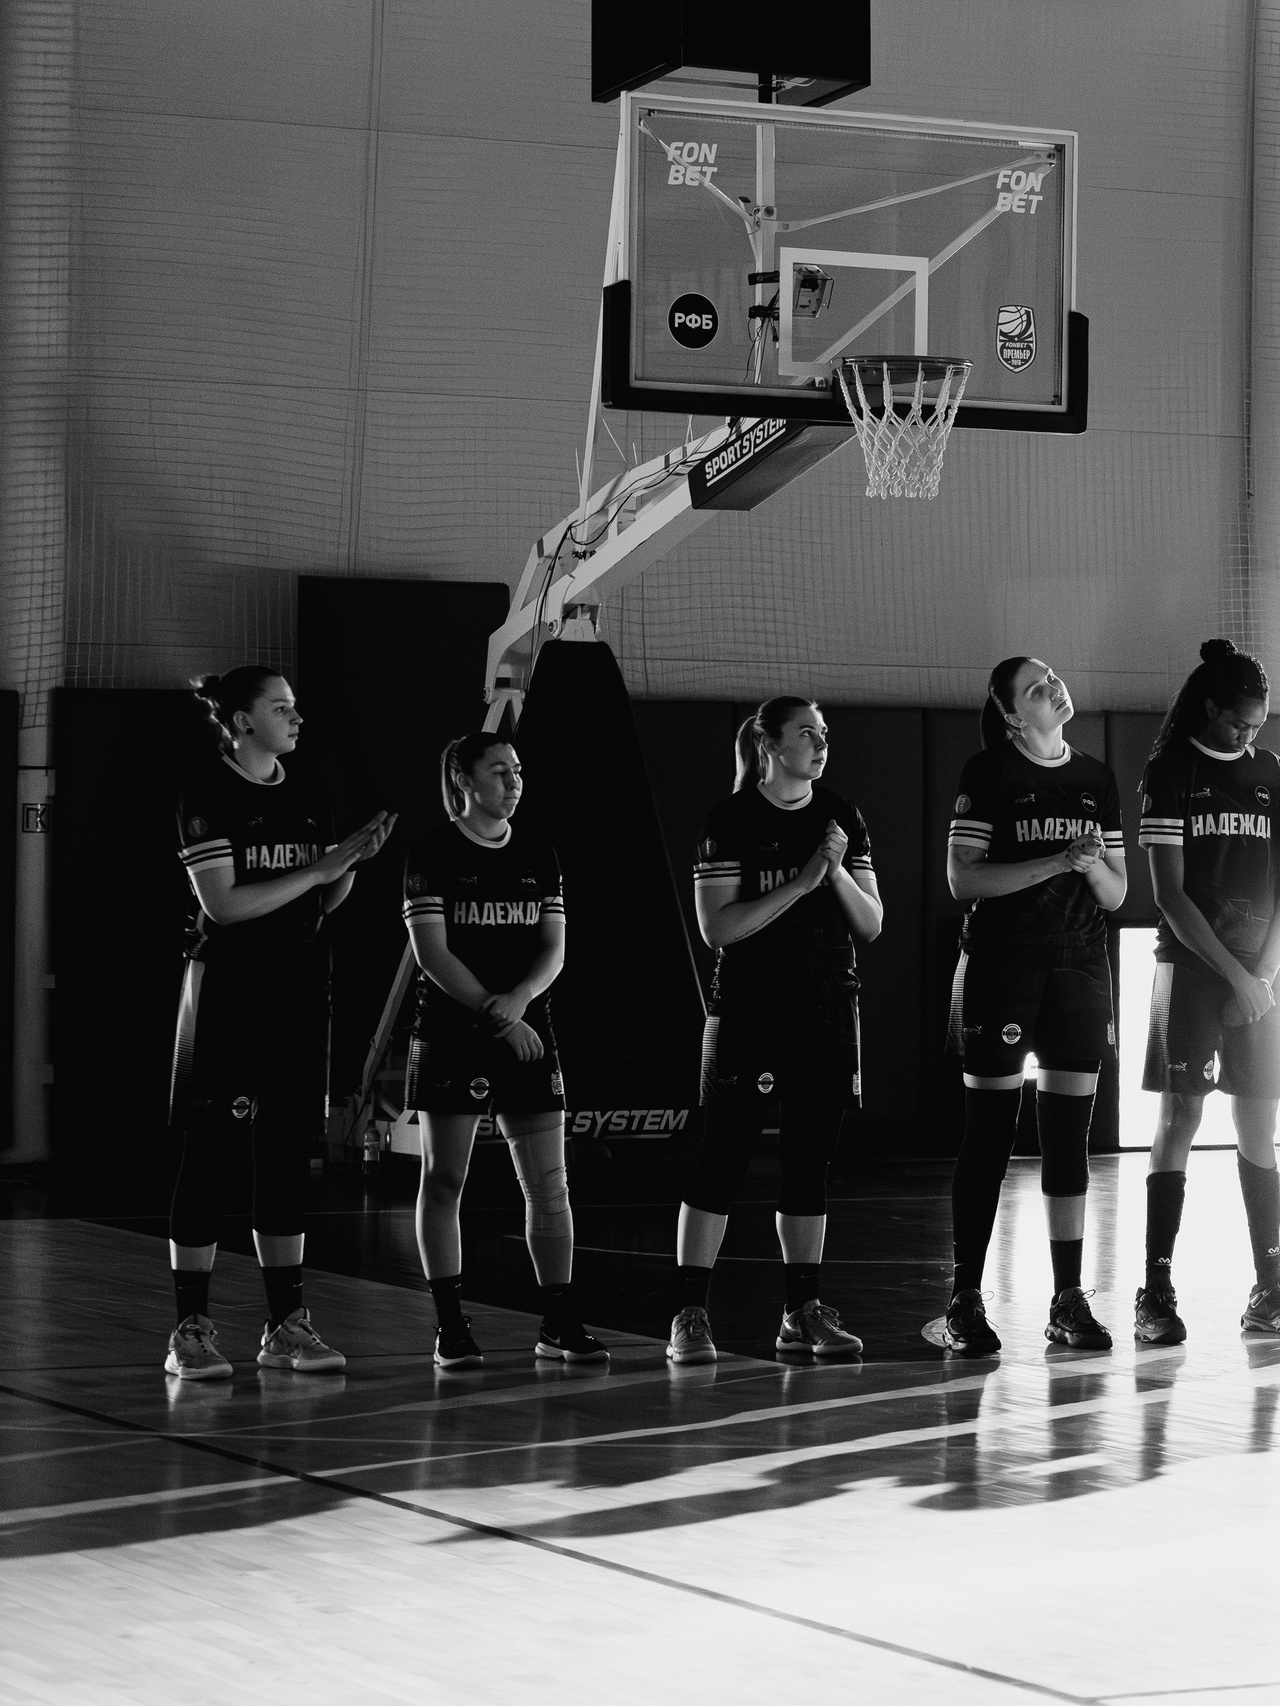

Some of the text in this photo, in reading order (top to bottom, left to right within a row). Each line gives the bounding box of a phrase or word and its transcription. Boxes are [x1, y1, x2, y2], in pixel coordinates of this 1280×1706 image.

[667, 141, 718, 164] FON
[667, 164, 718, 187] BET
[996, 170, 1043, 192] FON
[995, 192, 1044, 214] BET
[674, 312, 713, 330] РФБ
